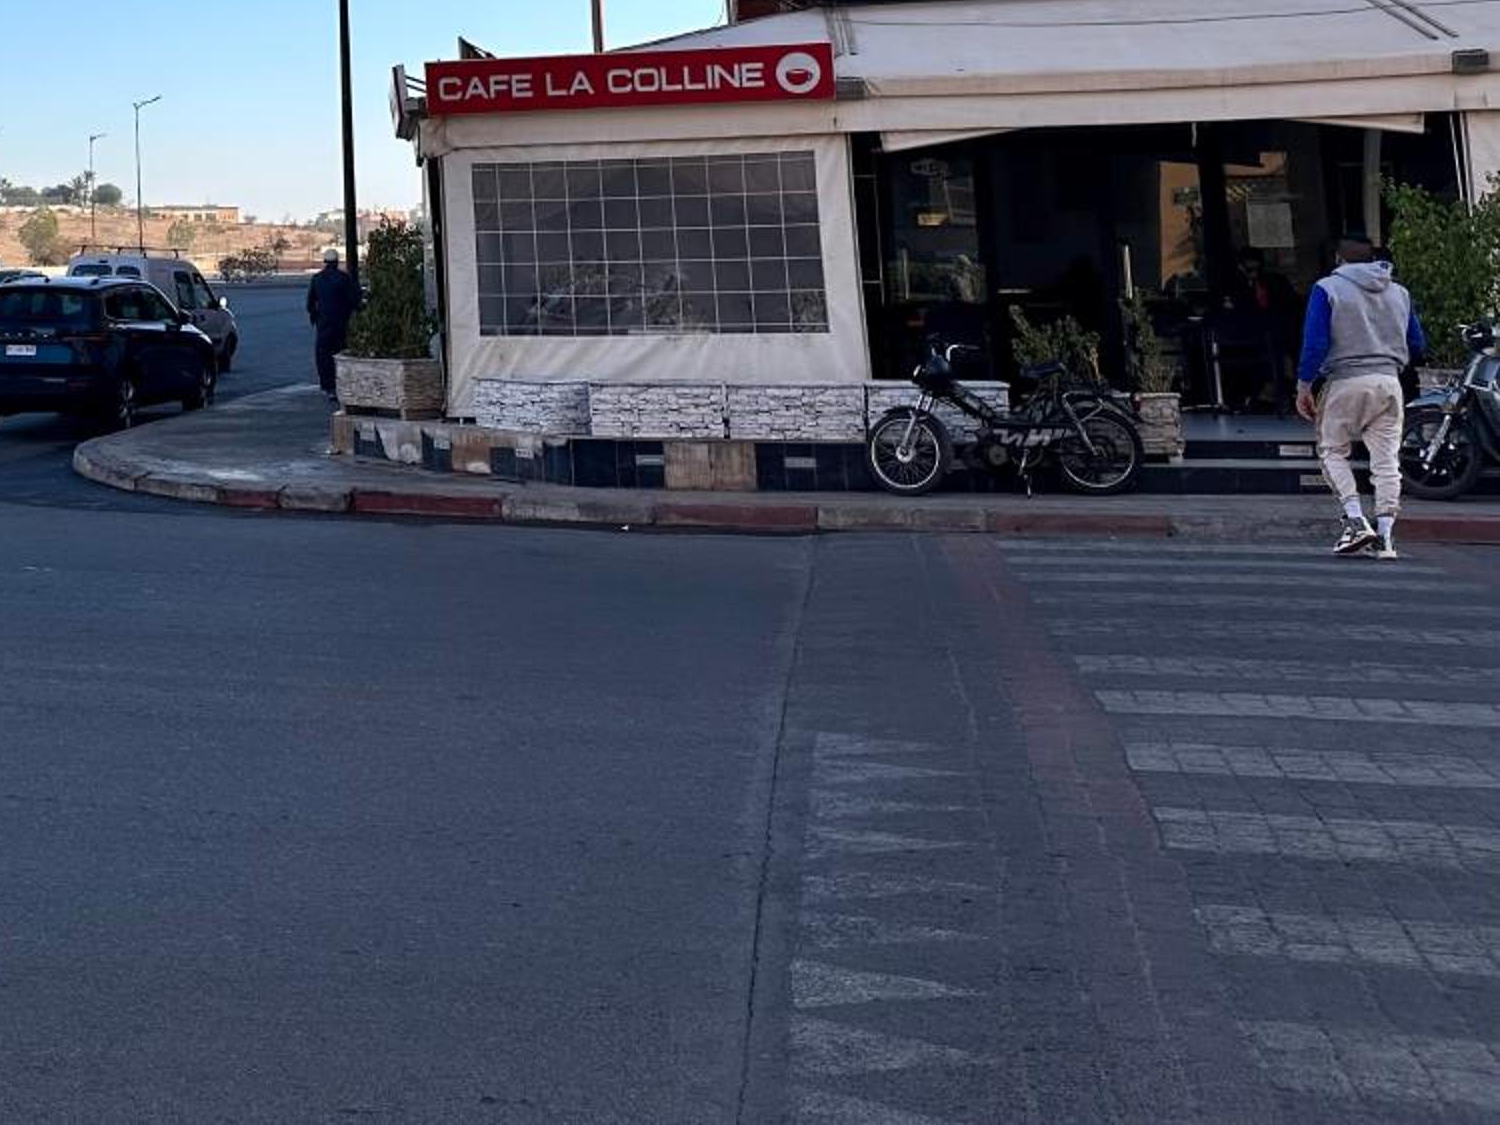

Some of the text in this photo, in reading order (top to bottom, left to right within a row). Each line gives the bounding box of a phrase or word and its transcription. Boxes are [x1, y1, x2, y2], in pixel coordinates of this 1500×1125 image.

[438, 62, 765, 101] CAFE LA COLLINE
